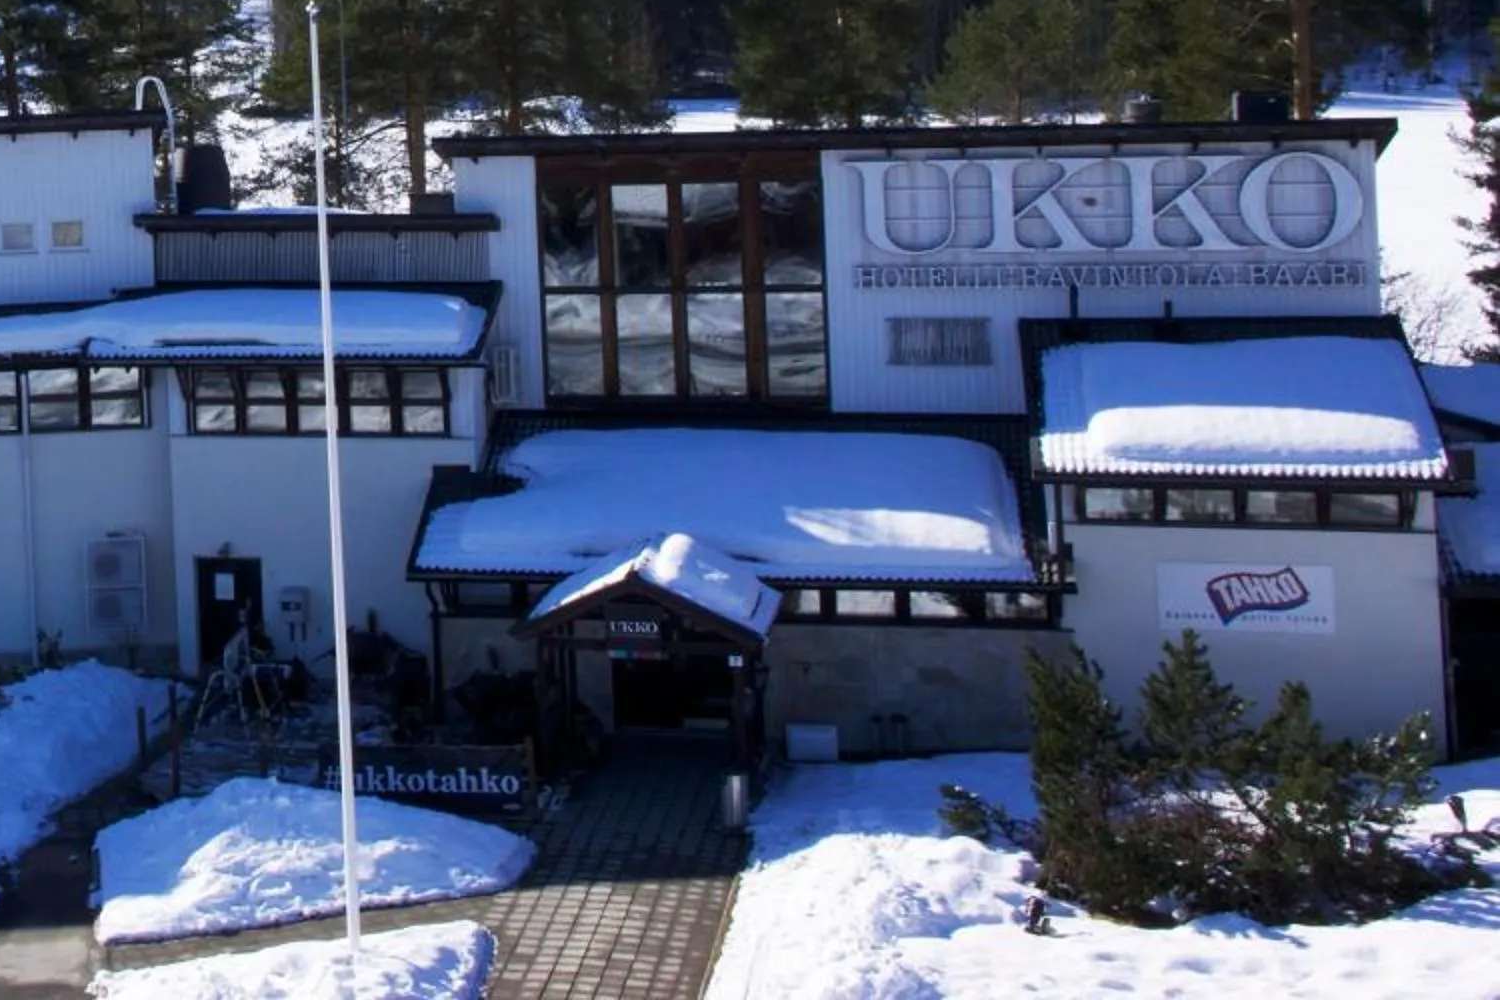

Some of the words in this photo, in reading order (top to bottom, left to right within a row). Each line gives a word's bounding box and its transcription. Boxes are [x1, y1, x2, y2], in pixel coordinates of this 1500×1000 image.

[843, 151, 1365, 254] UKKO
[856, 265, 1005, 290] HOTELLI
[1020, 264, 1228, 288] RAVINTOLA
[1249, 262, 1369, 287] BAARI
[1211, 571, 1304, 613] TAHKO
[610, 621, 659, 633] UKKO
